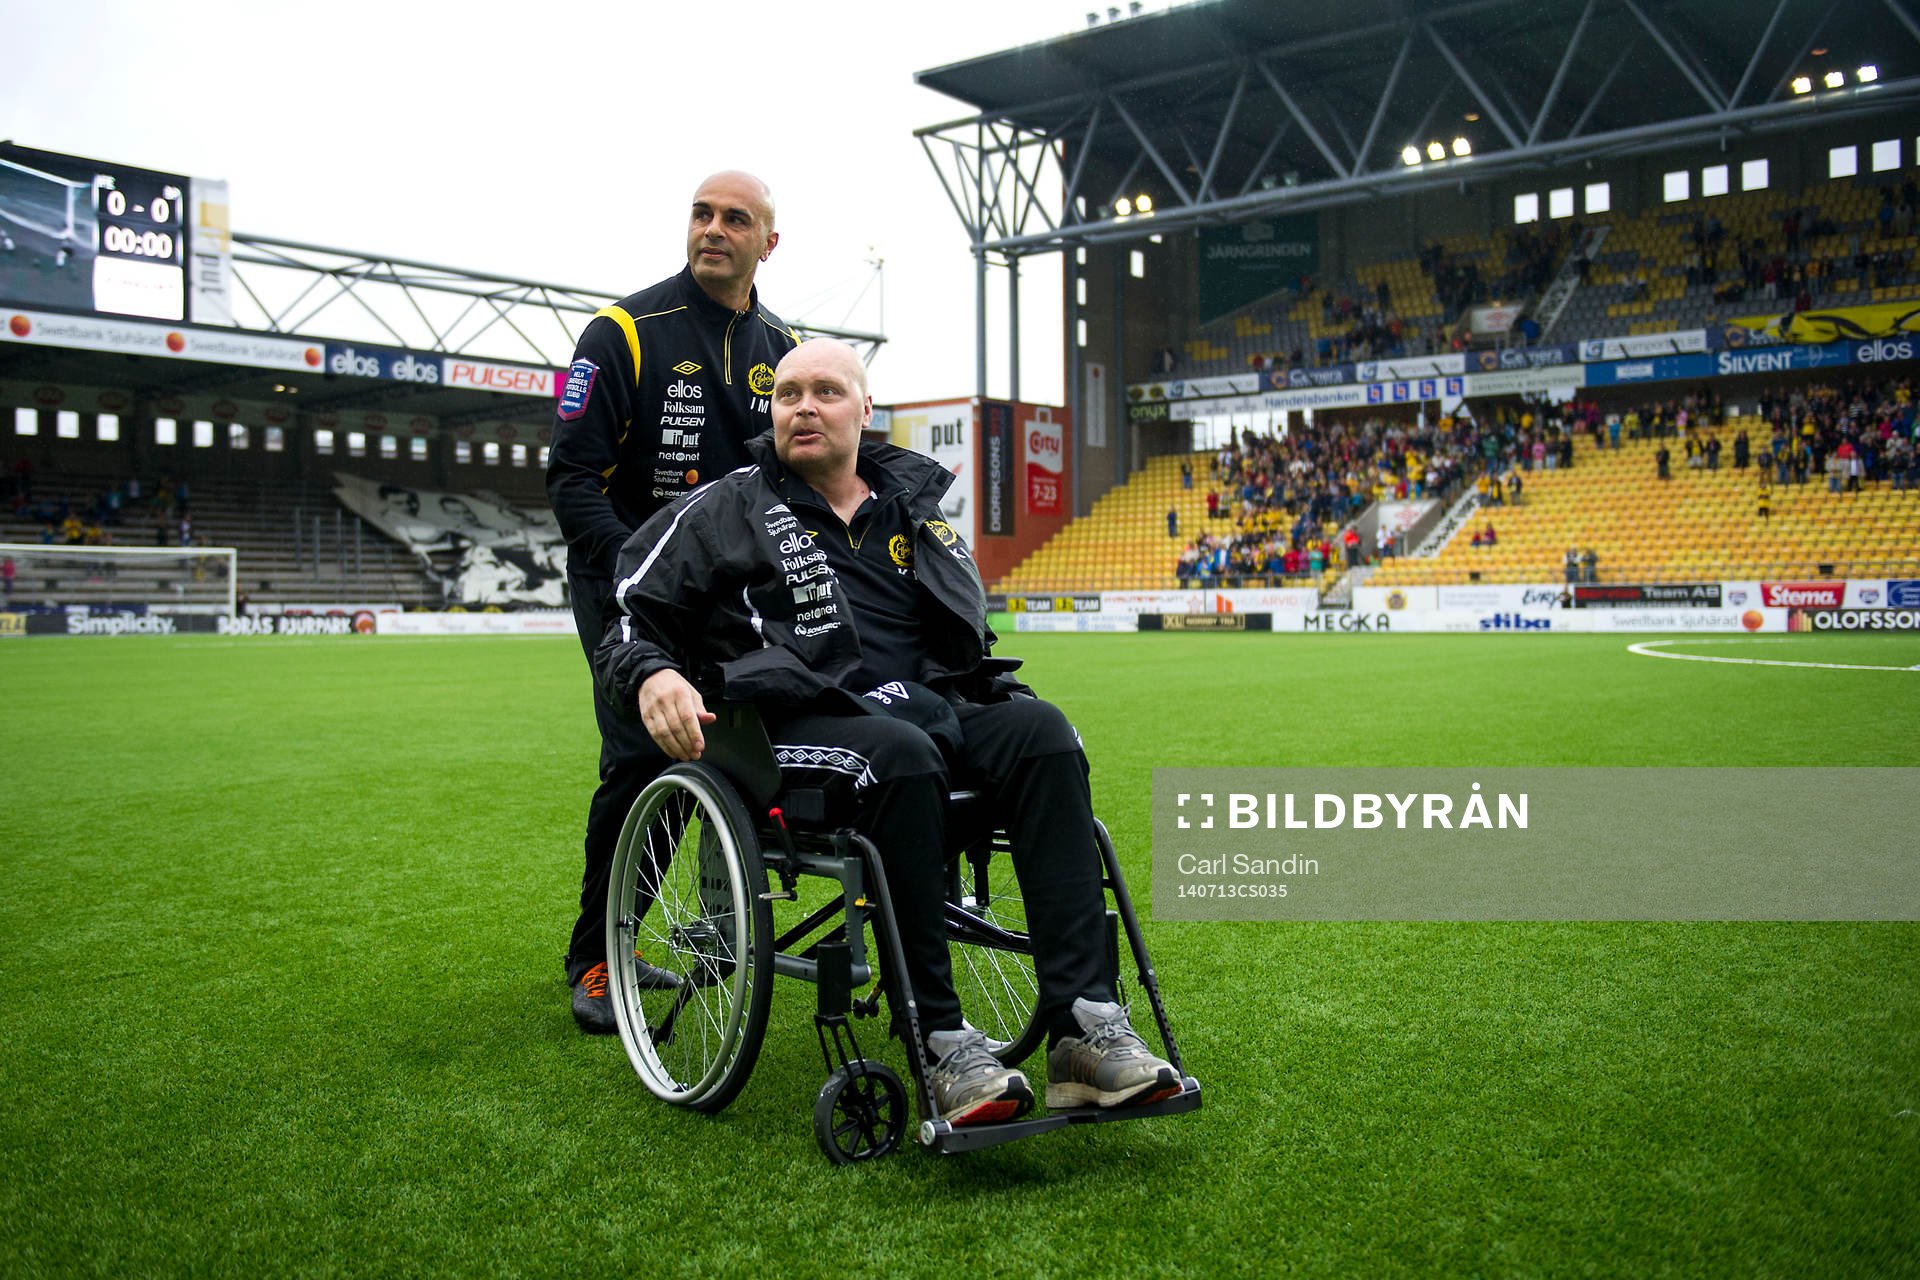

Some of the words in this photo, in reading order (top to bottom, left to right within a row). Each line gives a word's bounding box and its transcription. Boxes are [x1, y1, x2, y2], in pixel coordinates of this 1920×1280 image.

[107, 190, 126, 216] 0
[151, 197, 170, 223] 0
[104, 225, 173, 259] 00:00
[1857, 340, 1912, 363] ellos
[332, 349, 380, 378] ellos
[392, 355, 439, 384] ellos
[1718, 351, 1792, 375] SILVENT
[452, 363, 547, 391] PULSEN
[667, 379, 702, 398] ellos
[663, 401, 704, 414] Folksam
[758, 399, 769, 413] M
[1265, 391, 1359, 408] Handelsbanken
[1130, 404, 1166, 420] onyx
[660, 416, 705, 426] PULSEN
[654, 468, 683, 476] Swedbank
[1032, 485, 1057, 501] 7-23
[779, 532, 815, 554] ello
[1643, 587, 1688, 598] Team
[1692, 586, 1720, 598] AB
[1027, 599, 1050, 611] TEAM
[1074, 598, 1098, 611] TEAM
[1612, 614, 1676, 628] Swedbank
